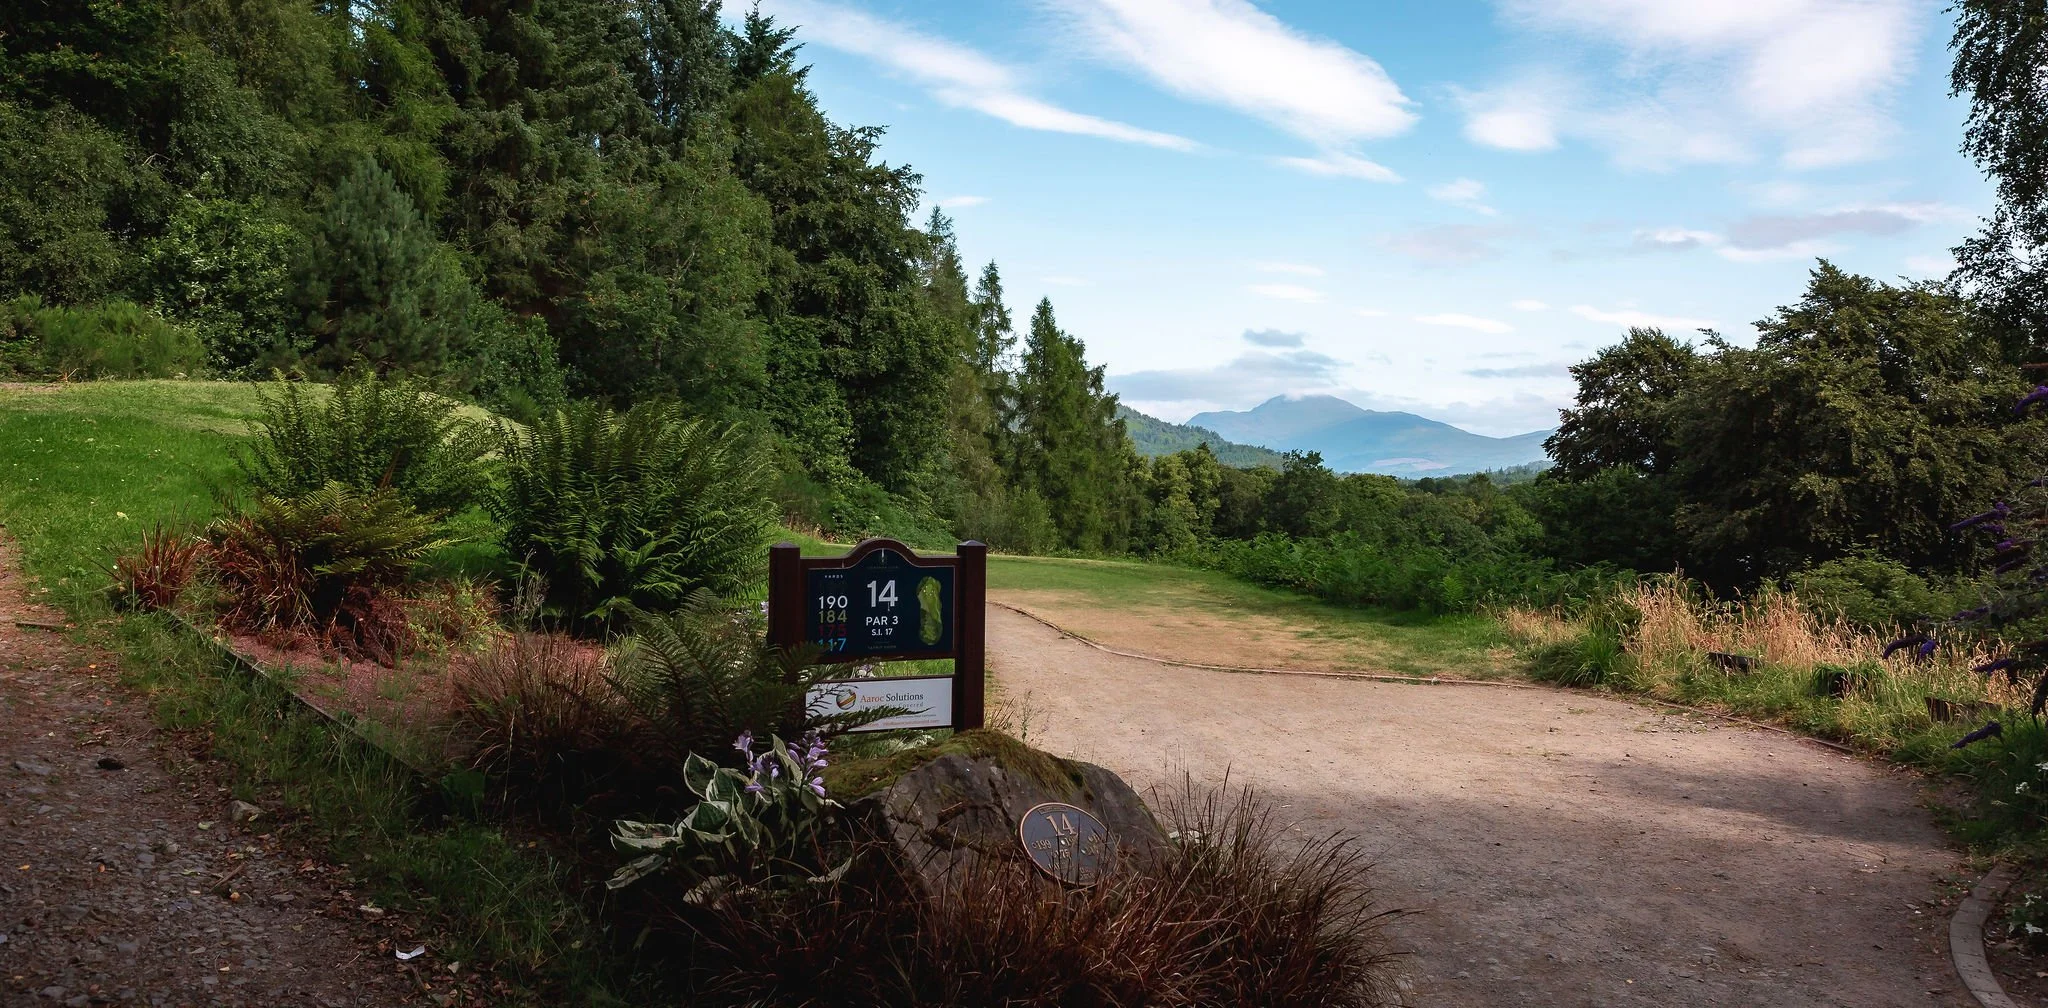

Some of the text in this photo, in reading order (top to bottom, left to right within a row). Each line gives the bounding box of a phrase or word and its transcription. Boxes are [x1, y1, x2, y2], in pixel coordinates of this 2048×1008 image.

[866, 579, 899, 609] 14
[818, 595, 848, 609] 190
[818, 609, 848, 624] 184
[865, 615, 899, 627] PAR 3
[871, 628, 893, 637] S.I. 17
[860, 692, 924, 704] Aaroc Solutions
[1046, 813, 1077, 837] 14
